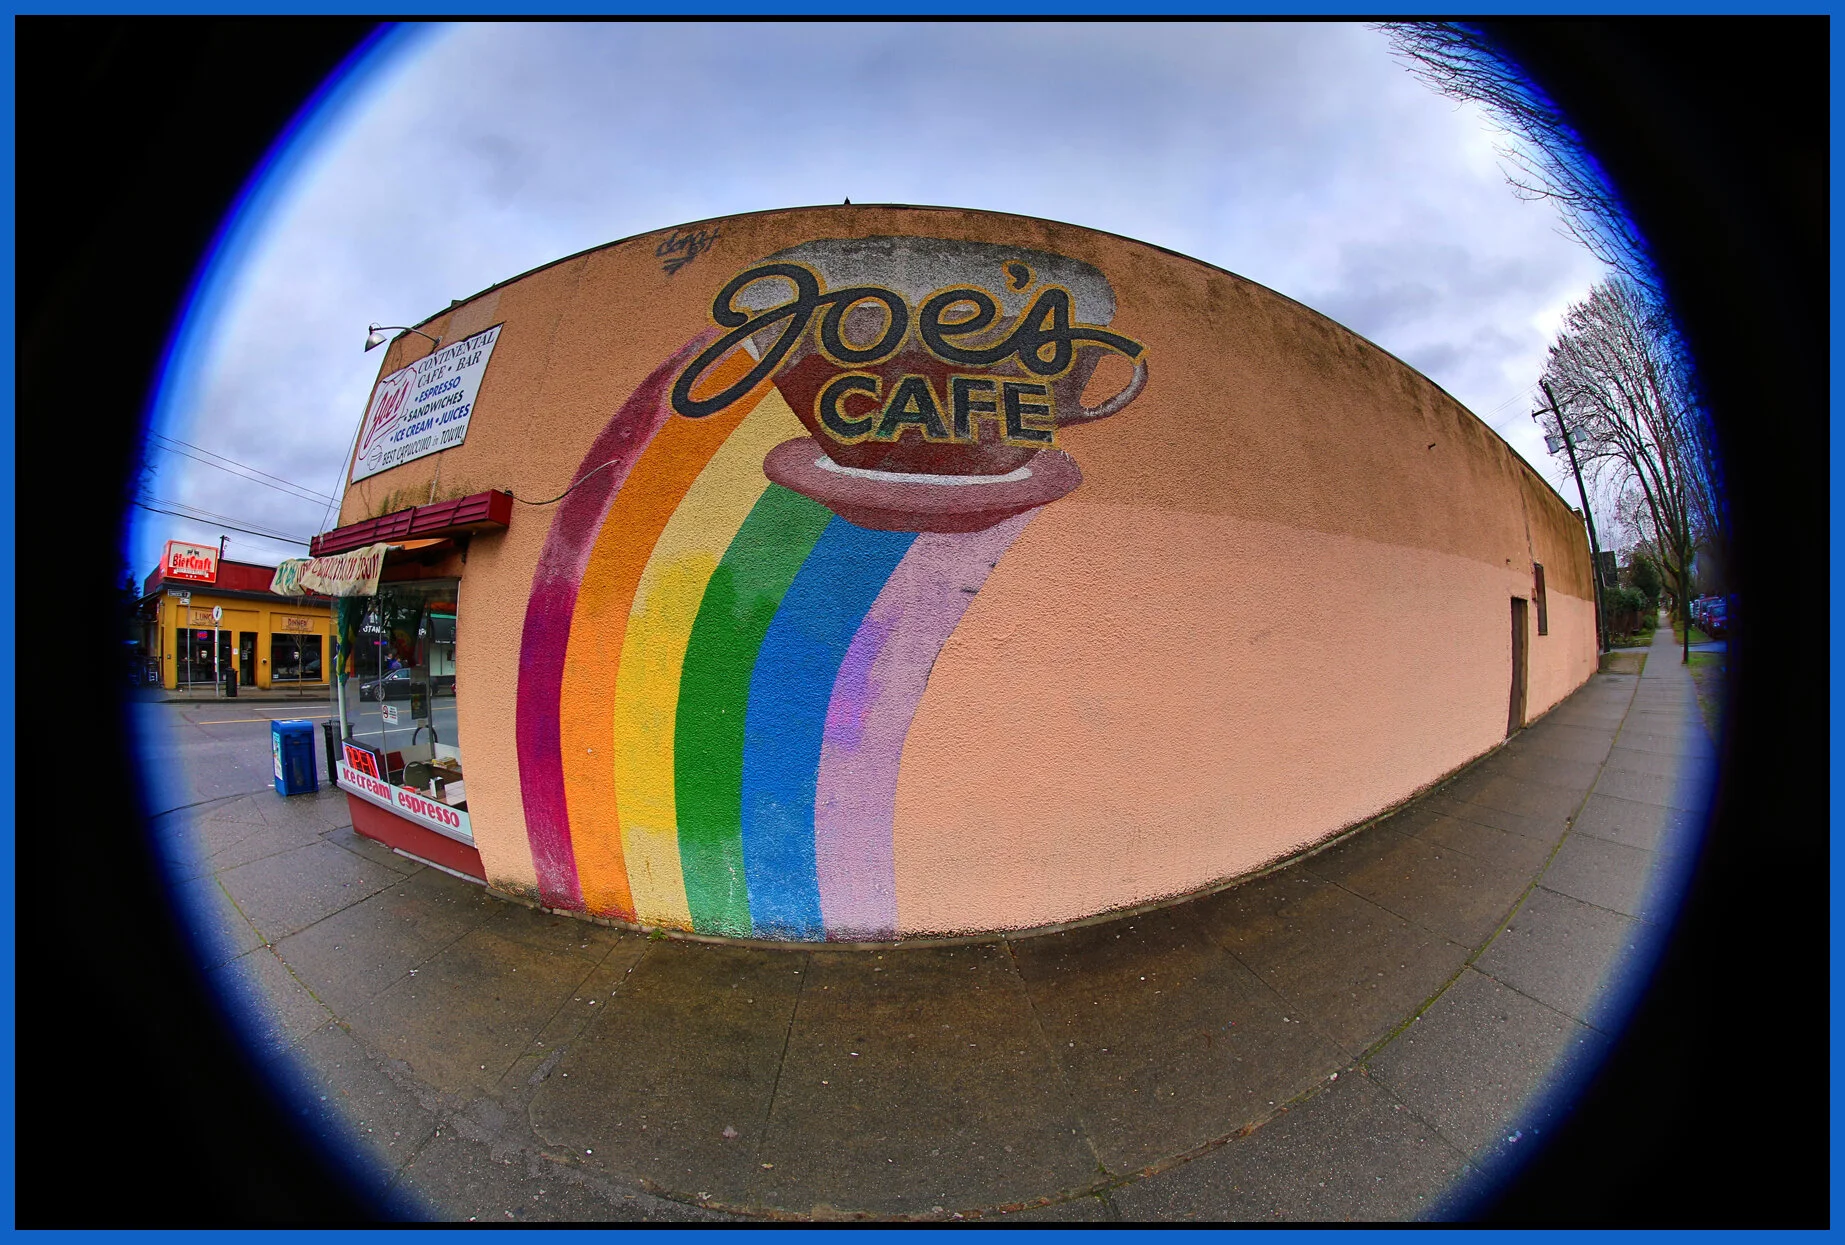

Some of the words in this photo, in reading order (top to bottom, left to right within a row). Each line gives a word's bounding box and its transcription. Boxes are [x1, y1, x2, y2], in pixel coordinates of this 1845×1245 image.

[418, 331, 495, 374] CONTINENTAL
[671, 258, 1149, 418] Joe's
[418, 365, 446, 388] CAFE
[456, 350, 482, 372] BAR
[419, 375, 461, 403] ESPRESSO
[393, 428, 406, 443] ICE
[406, 417, 434, 438] CREAM
[438, 403, 471, 425] JUICES
[407, 390, 464, 422] SANDWICHES
[814, 373, 1058, 446] CAFE
[382, 450, 397, 466] BEST
[440, 424, 465, 445] TOWN!
[345, 745, 379, 779] OPEN
[342, 768, 356, 784] ice
[356, 774, 391, 800] cream
[398, 791, 460, 828] espresso
